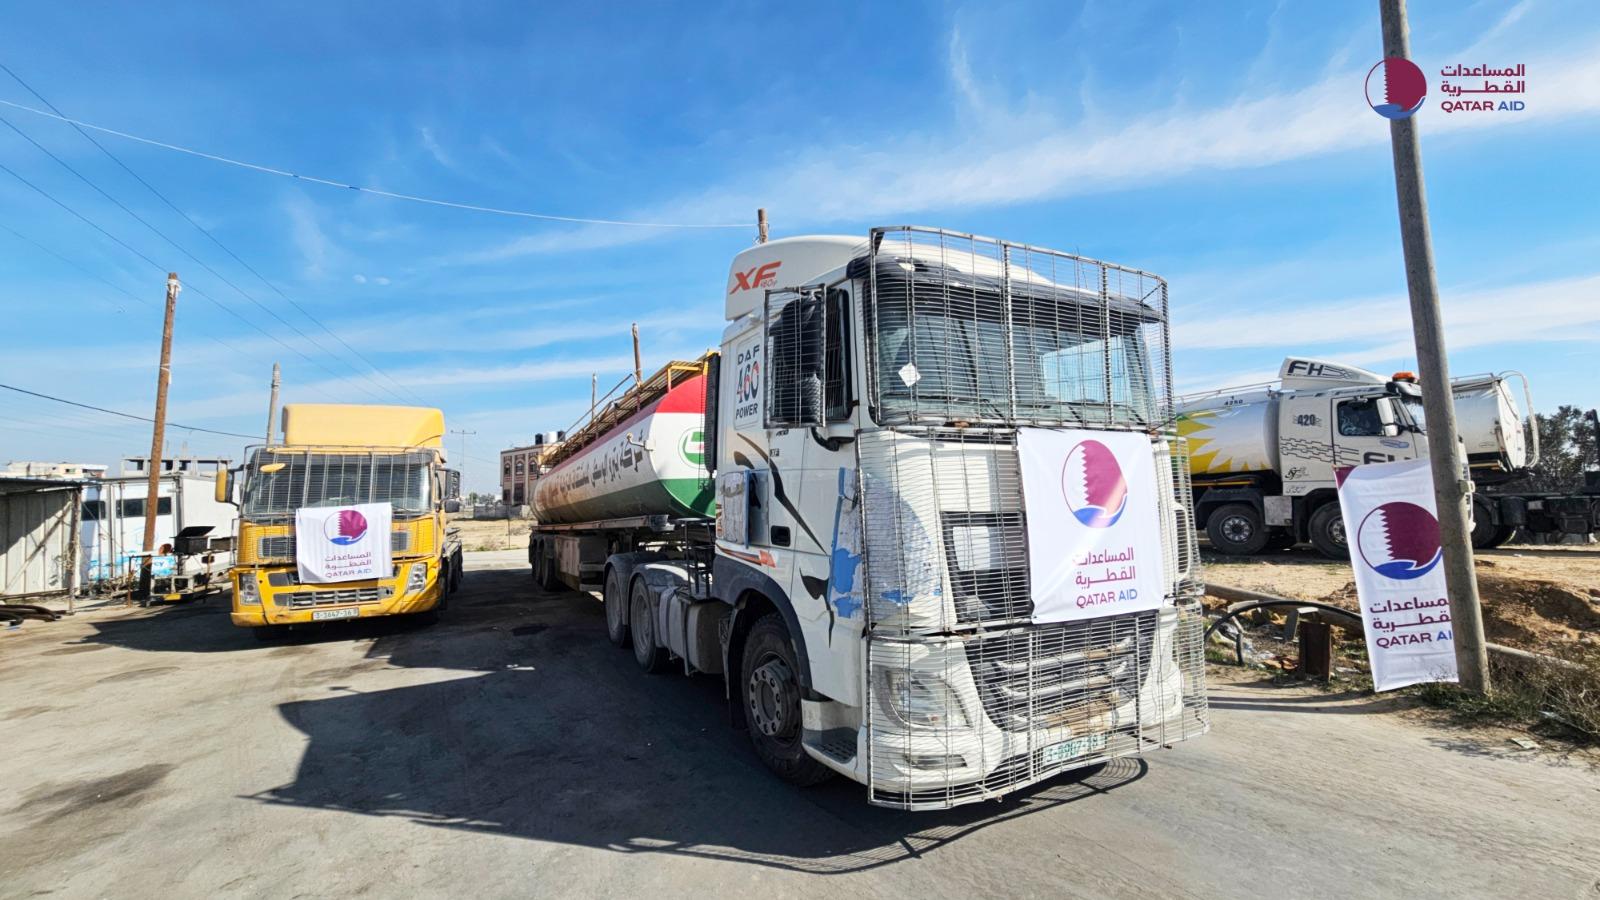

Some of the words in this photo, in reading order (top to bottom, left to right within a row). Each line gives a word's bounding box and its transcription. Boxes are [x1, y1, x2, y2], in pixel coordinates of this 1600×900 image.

[729, 260, 782, 295] XF
[737, 344, 760, 365] DAF
[1287, 360, 1324, 376] FH
[736, 360, 760, 404] 460
[735, 402, 759, 420] POWER
[1297, 414, 1316, 426] 420
[325, 569, 355, 578] QATAR
[1075, 565, 1136, 590] القطرية
[1076, 591, 1116, 609] QATAR
[1118, 588, 1138, 602] AID
[1370, 597, 1450, 613] مساعدات
[1372, 612, 1452, 632] قطرية
[1376, 632, 1432, 649] QATAR
[1436, 630, 1452, 642] AI
